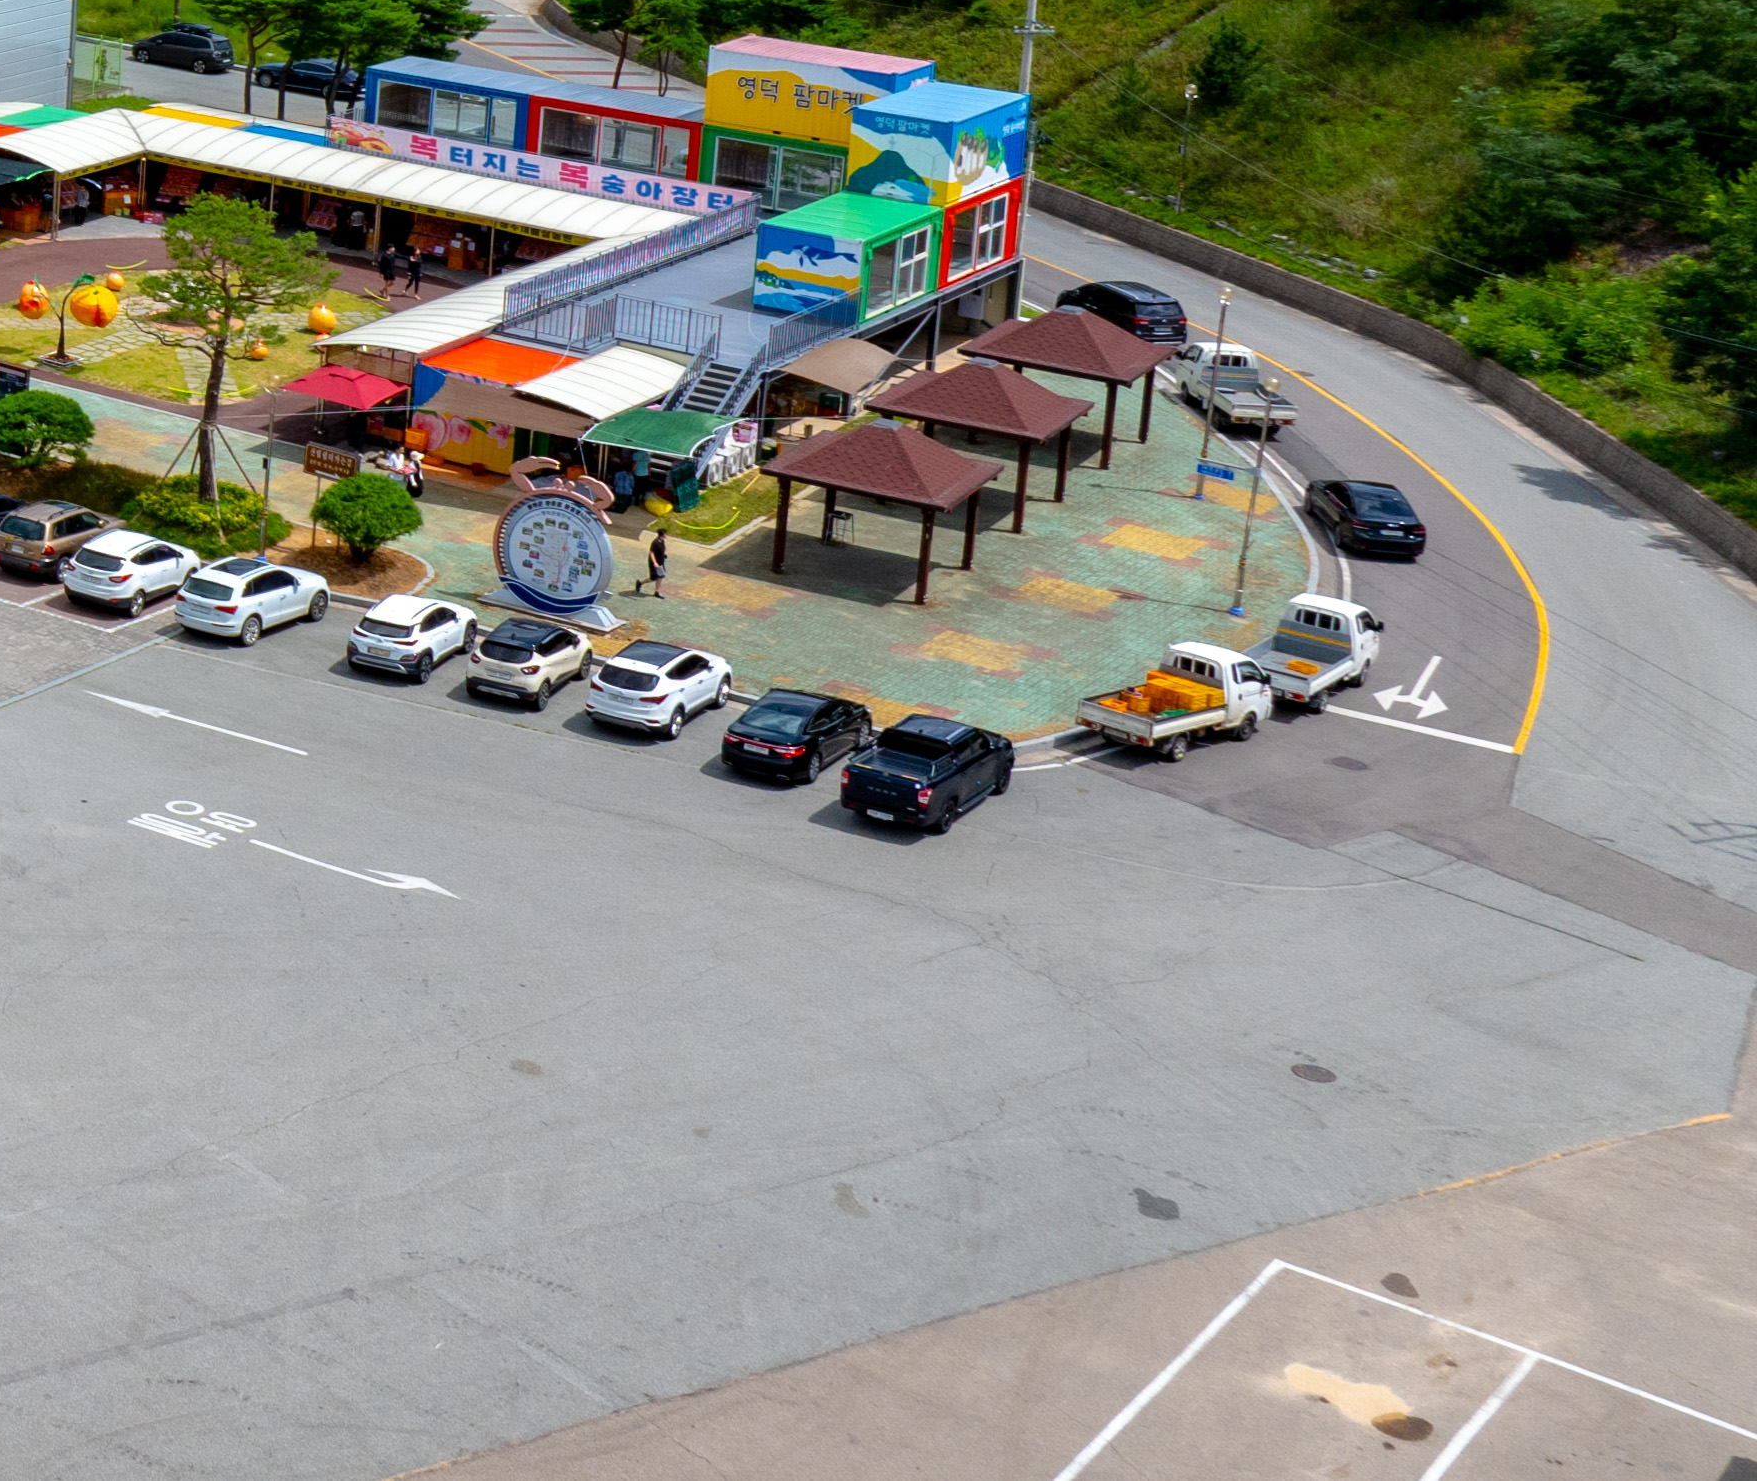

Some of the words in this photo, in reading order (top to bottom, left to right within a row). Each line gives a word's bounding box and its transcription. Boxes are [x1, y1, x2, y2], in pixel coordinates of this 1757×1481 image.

[737, 75, 781, 104] 영덕
[792, 82, 866, 115] 팜마켓
[875, 116, 896, 131] 영덕
[897, 118, 931, 135] 팜마켓
